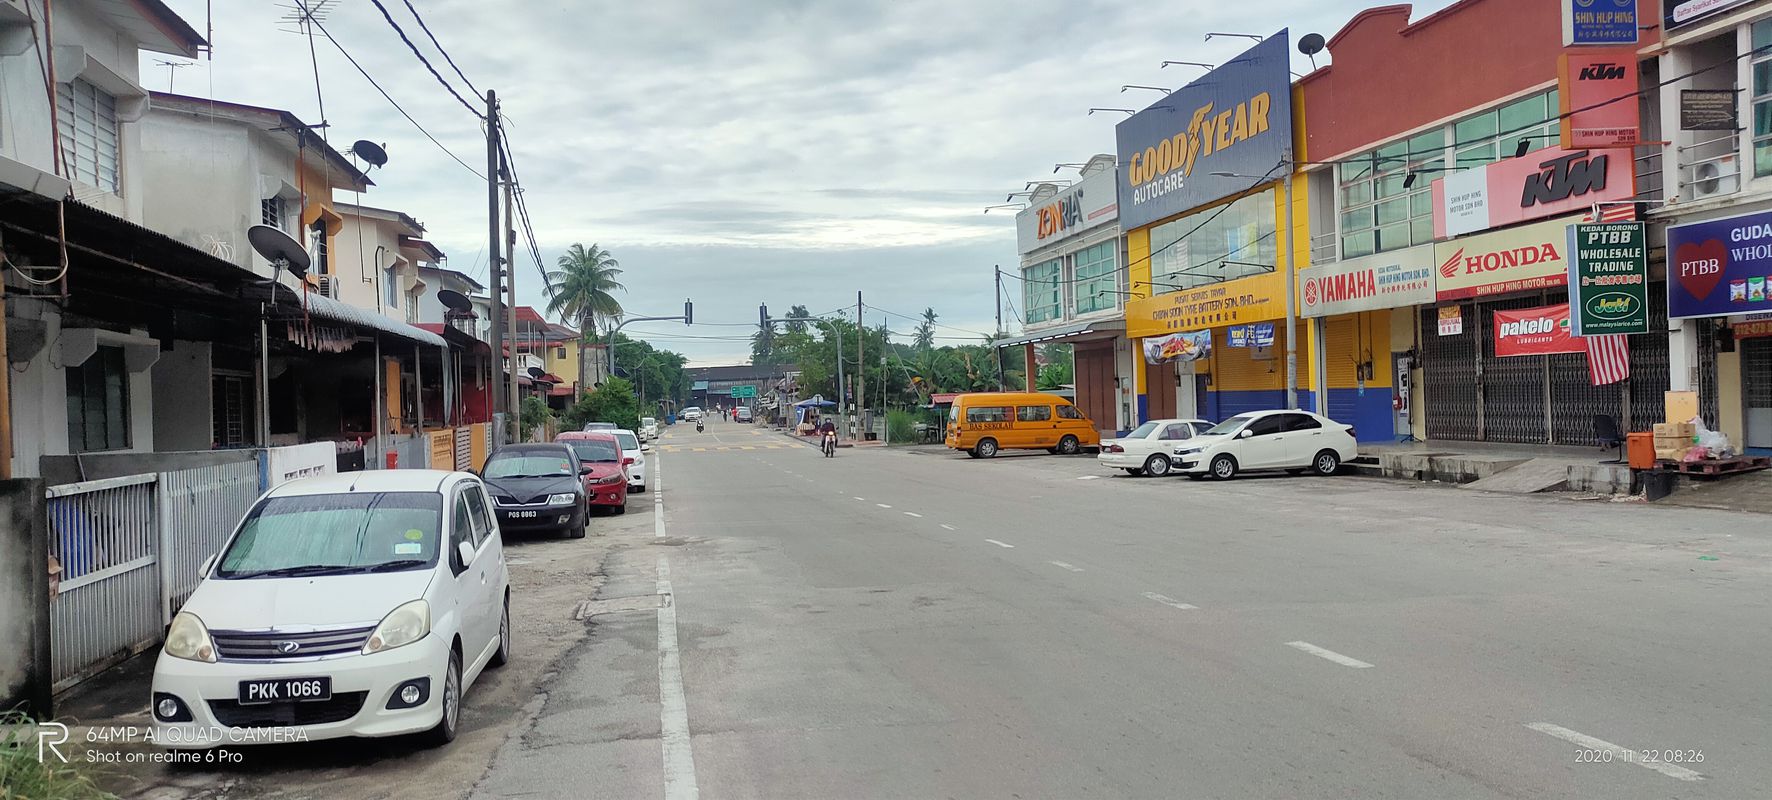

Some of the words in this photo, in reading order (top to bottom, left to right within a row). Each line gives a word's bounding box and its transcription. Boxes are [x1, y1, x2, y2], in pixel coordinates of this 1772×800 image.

[1575, 11, 1595, 24] SHIN
[1596, 11, 1613, 24] HUP
[1614, 11, 1634, 24] HING
[1579, 63, 1626, 80] KTM
[1520, 150, 1607, 209] KTM
[1134, 171, 1184, 206] AUTOCARE
[1606, 223, 1639, 232] BORONG
[1588, 231, 1632, 245] PTBB
[1465, 243, 1560, 275] HONDA
[1580, 248, 1641, 260] WHOLESALE
[1588, 261, 1634, 272] TRADING
[1681, 258, 1719, 277] PTBB
[1319, 268, 1376, 303] YAMAHA
[1476, 285, 1491, 295] SHIN
[1491, 283, 1504, 293] HUP
[1505, 281, 1521, 291] HING
[1522, 278, 1546, 288] MOTOR
[1199, 299, 1224, 313] BATTERY
[1499, 317, 1554, 339] pakelo
[1585, 321, 1642, 329] www.malaysiarice.com
[969, 422, 982, 430] BAS
[984, 421, 1014, 430] SEKOLAH
[249, 682, 279, 700] PKK
[285, 680, 321, 698] 1066
